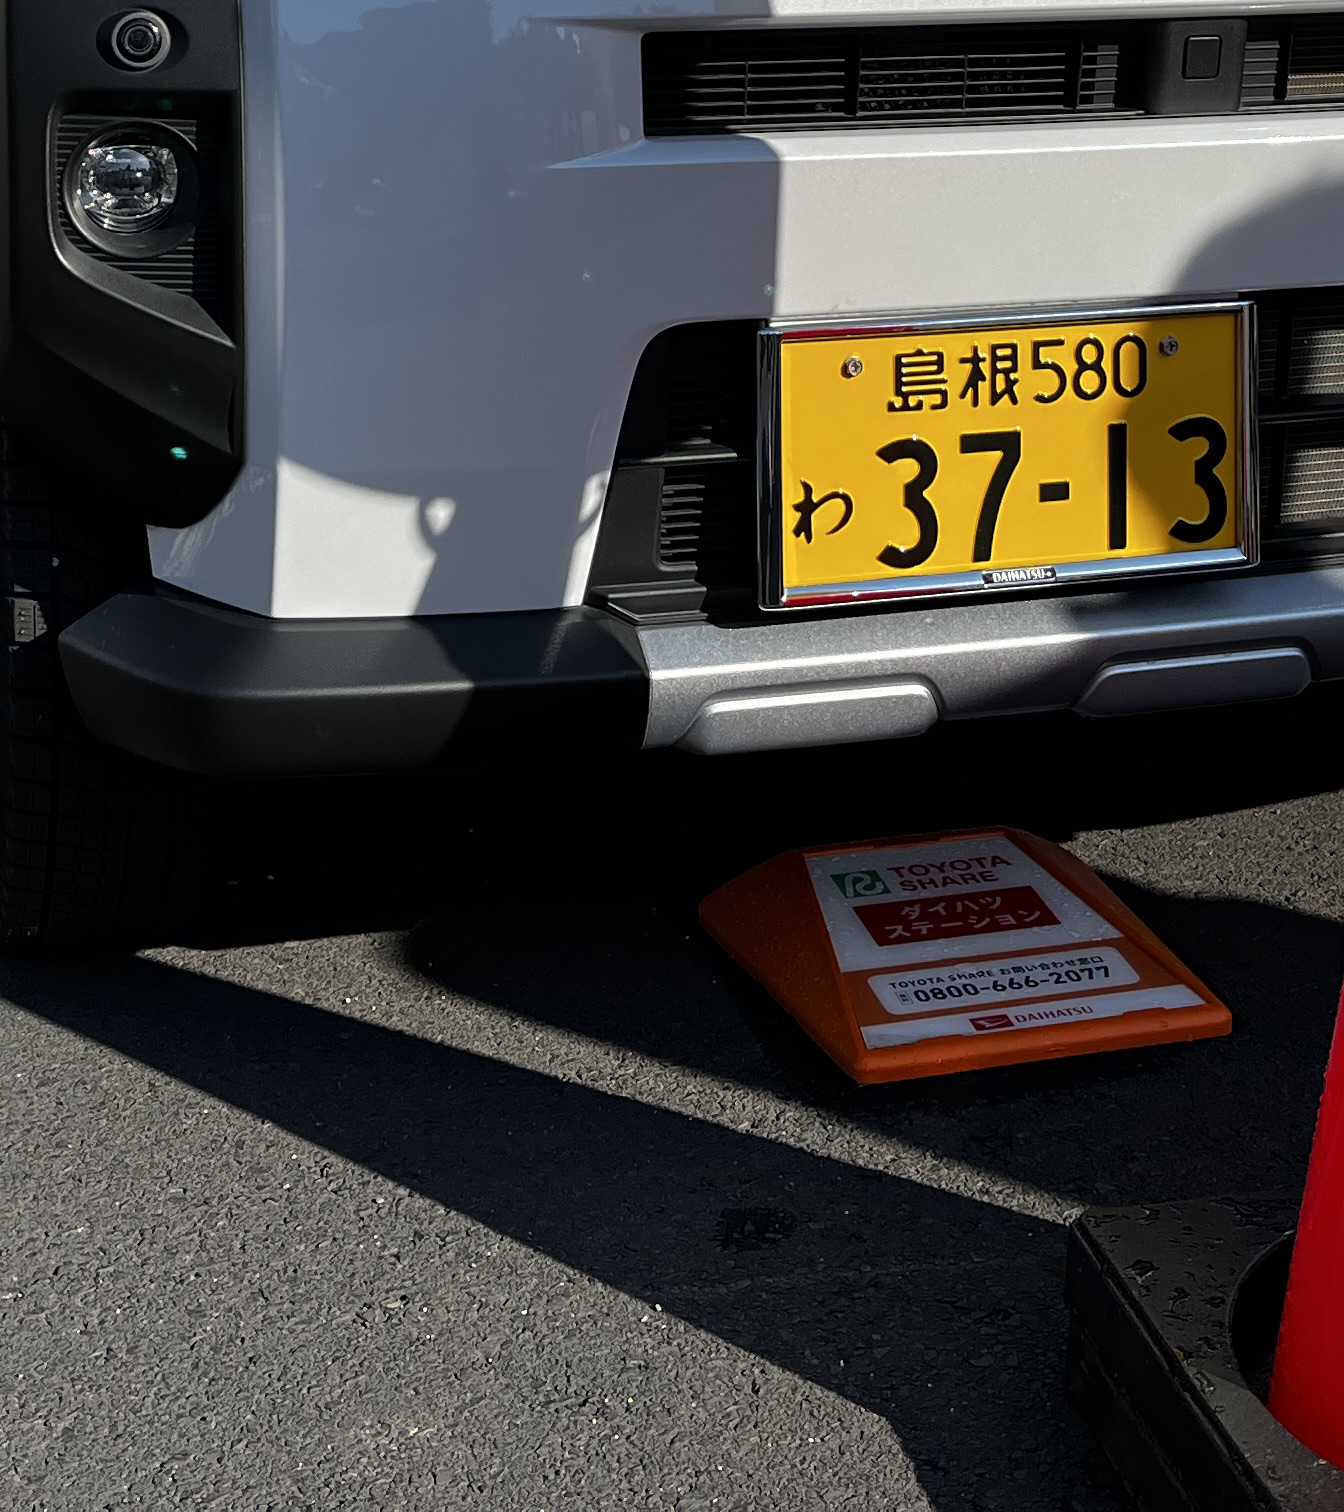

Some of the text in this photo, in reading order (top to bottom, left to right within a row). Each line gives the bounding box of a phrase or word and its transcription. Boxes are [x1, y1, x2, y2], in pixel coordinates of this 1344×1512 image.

[791, 415, 1229, 570] わ 37-13
[992, 569, 1045, 583] DAIHATSU
[888, 855, 1012, 879] TOYOTA
[899, 871, 998, 891] SHARE
[900, 896, 1002, 920] ダイハツ
[884, 909, 1042, 939] ステーション
[888, 956, 1104, 989] TOYOTA SHARE お問い合わせ窓口
[913, 965, 1110, 1003] 0800-666-2077
[1014, 1006, 1094, 1024] DAIHATSU
